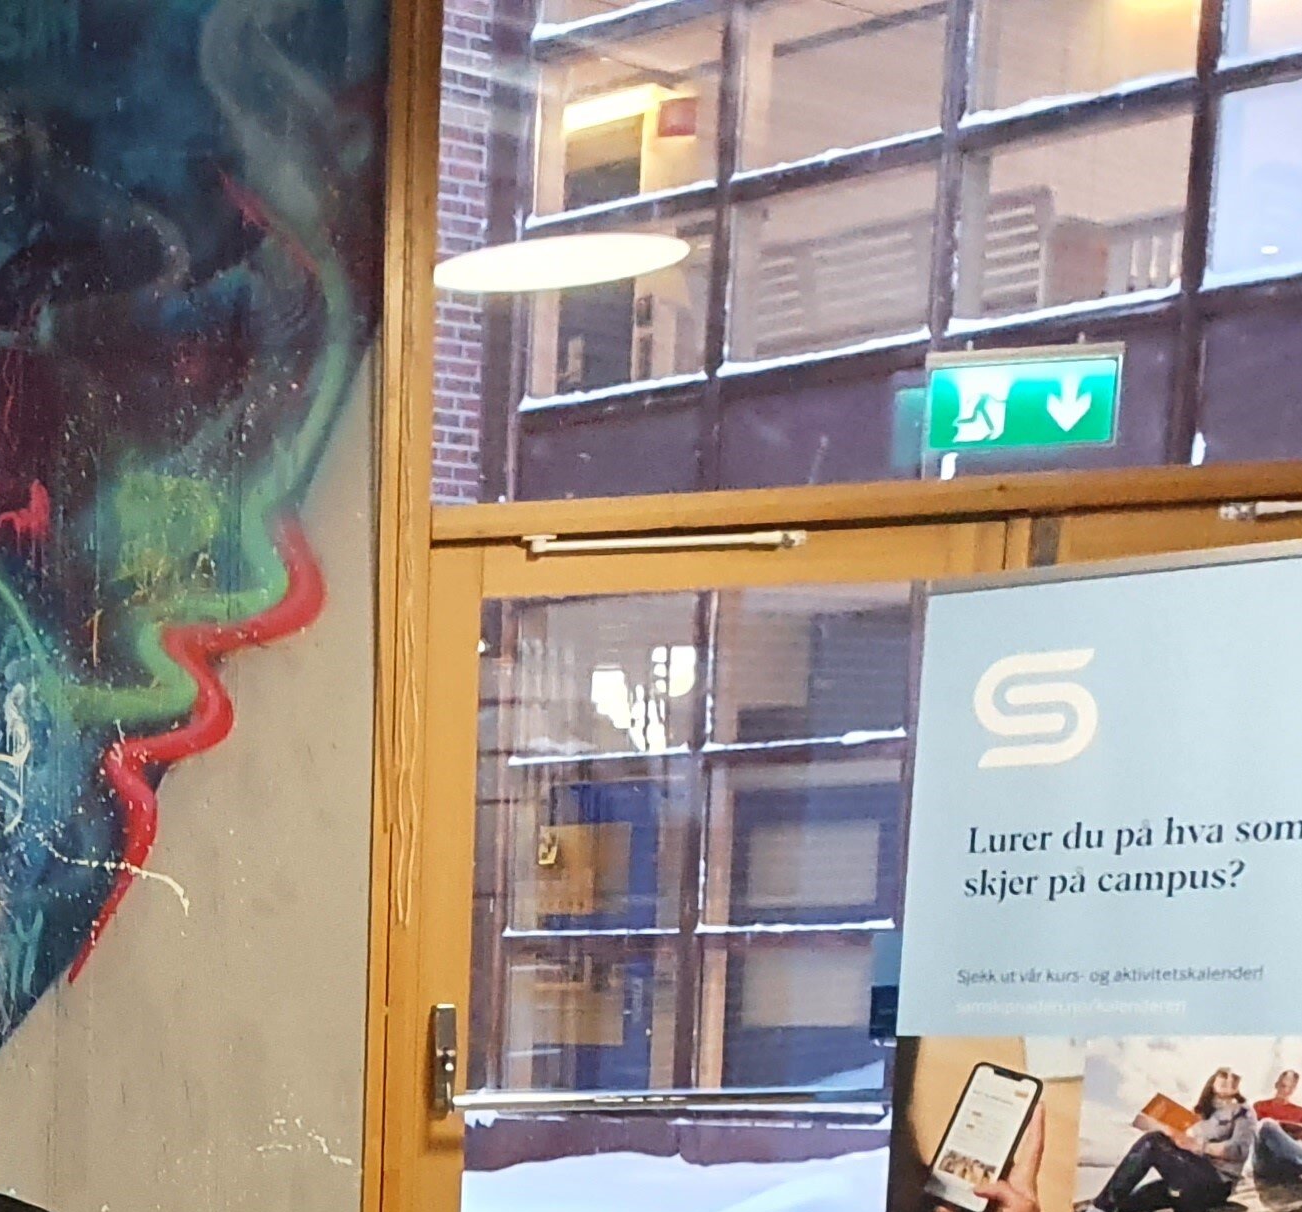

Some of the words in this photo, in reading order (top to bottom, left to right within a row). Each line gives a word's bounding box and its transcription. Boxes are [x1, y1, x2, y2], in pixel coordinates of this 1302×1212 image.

[968, 826, 1053, 854] Lurer
[1062, 821, 1104, 850] du
[1115, 819, 1153, 855] på
[1164, 817, 1224, 846] hva
[964, 868, 1039, 903] skjer
[1048, 867, 1086, 902] på
[1097, 859, 1246, 898] campus?
[957, 968, 996, 987] Sjekk
[1000, 970, 1015, 983] ut
[1018, 967, 1042, 983] vår
[1046, 968, 1084, 983] kurs-
[1089, 969, 1110, 986] og
[1113, 965, 1263, 982] aktivitetskalender!
